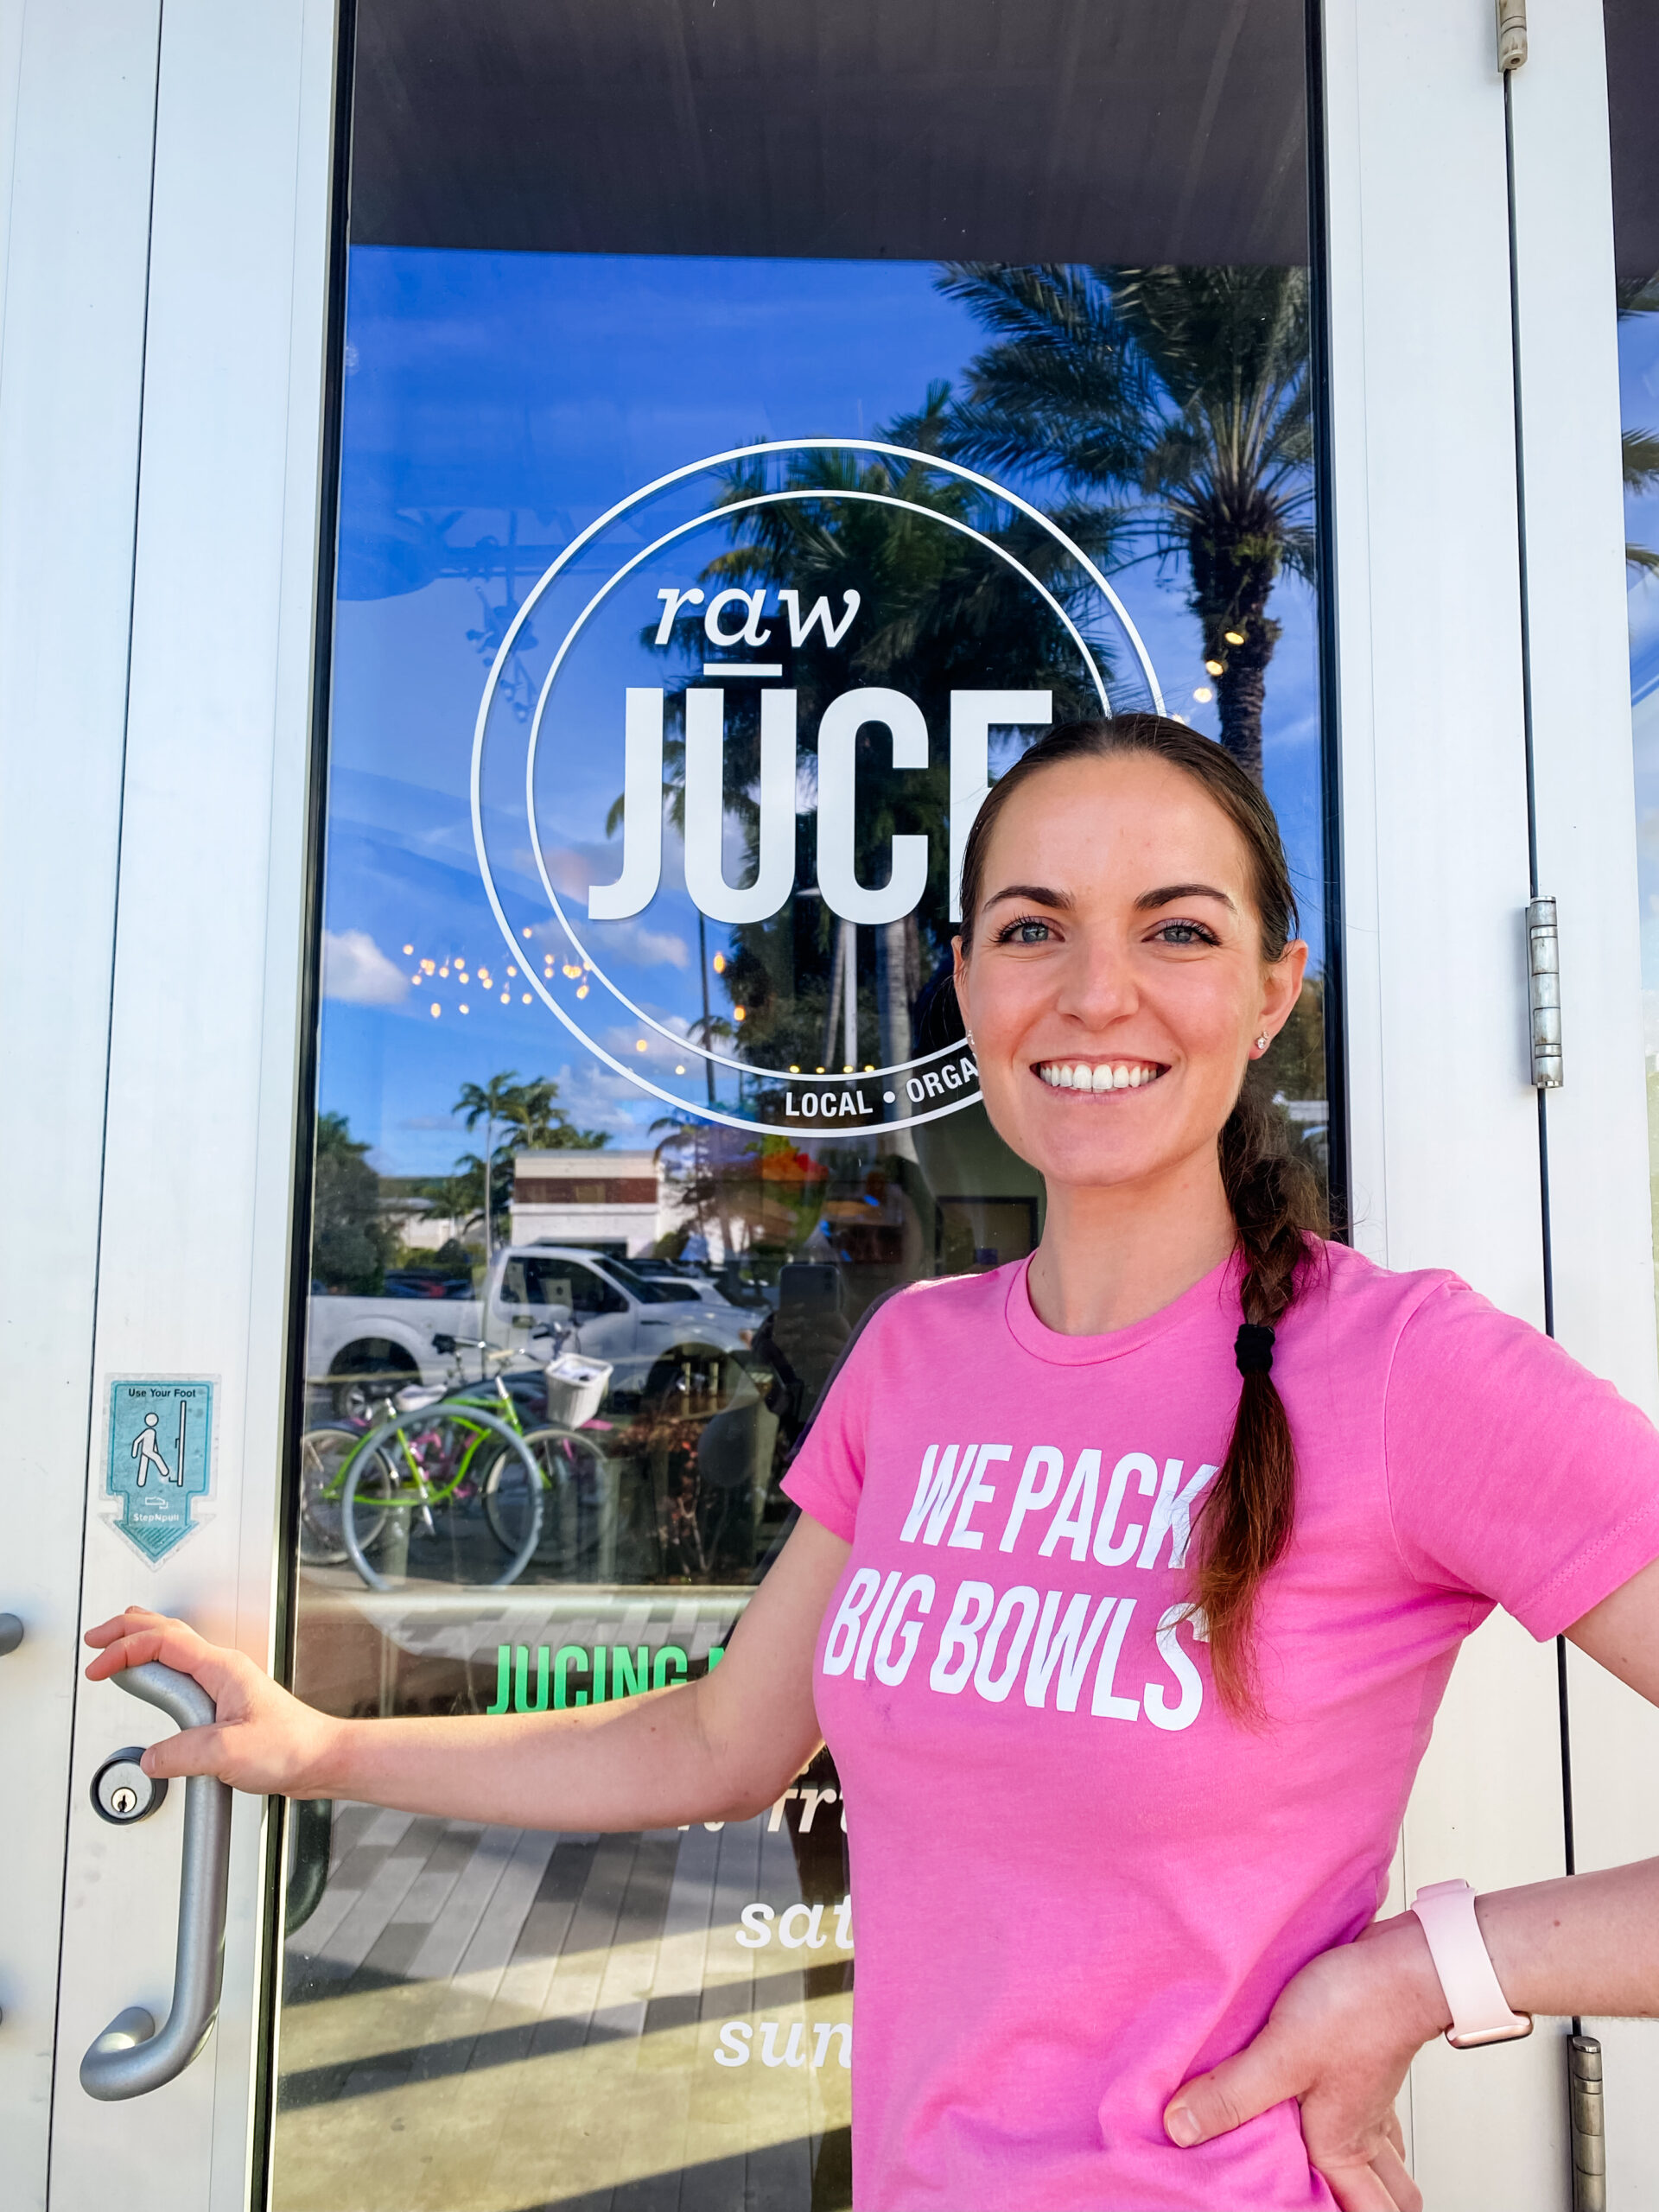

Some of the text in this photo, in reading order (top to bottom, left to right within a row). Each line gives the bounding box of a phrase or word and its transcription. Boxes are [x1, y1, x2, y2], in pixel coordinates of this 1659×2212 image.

[654, 588, 861, 648] raw
[785, 1052, 979, 1118] LOCAL ORGA
[128, 1388, 196, 1398] Use Your Foot
[899, 1443, 1219, 1569] WE PACK
[822, 1567, 1211, 1732] BIG BOWLS
